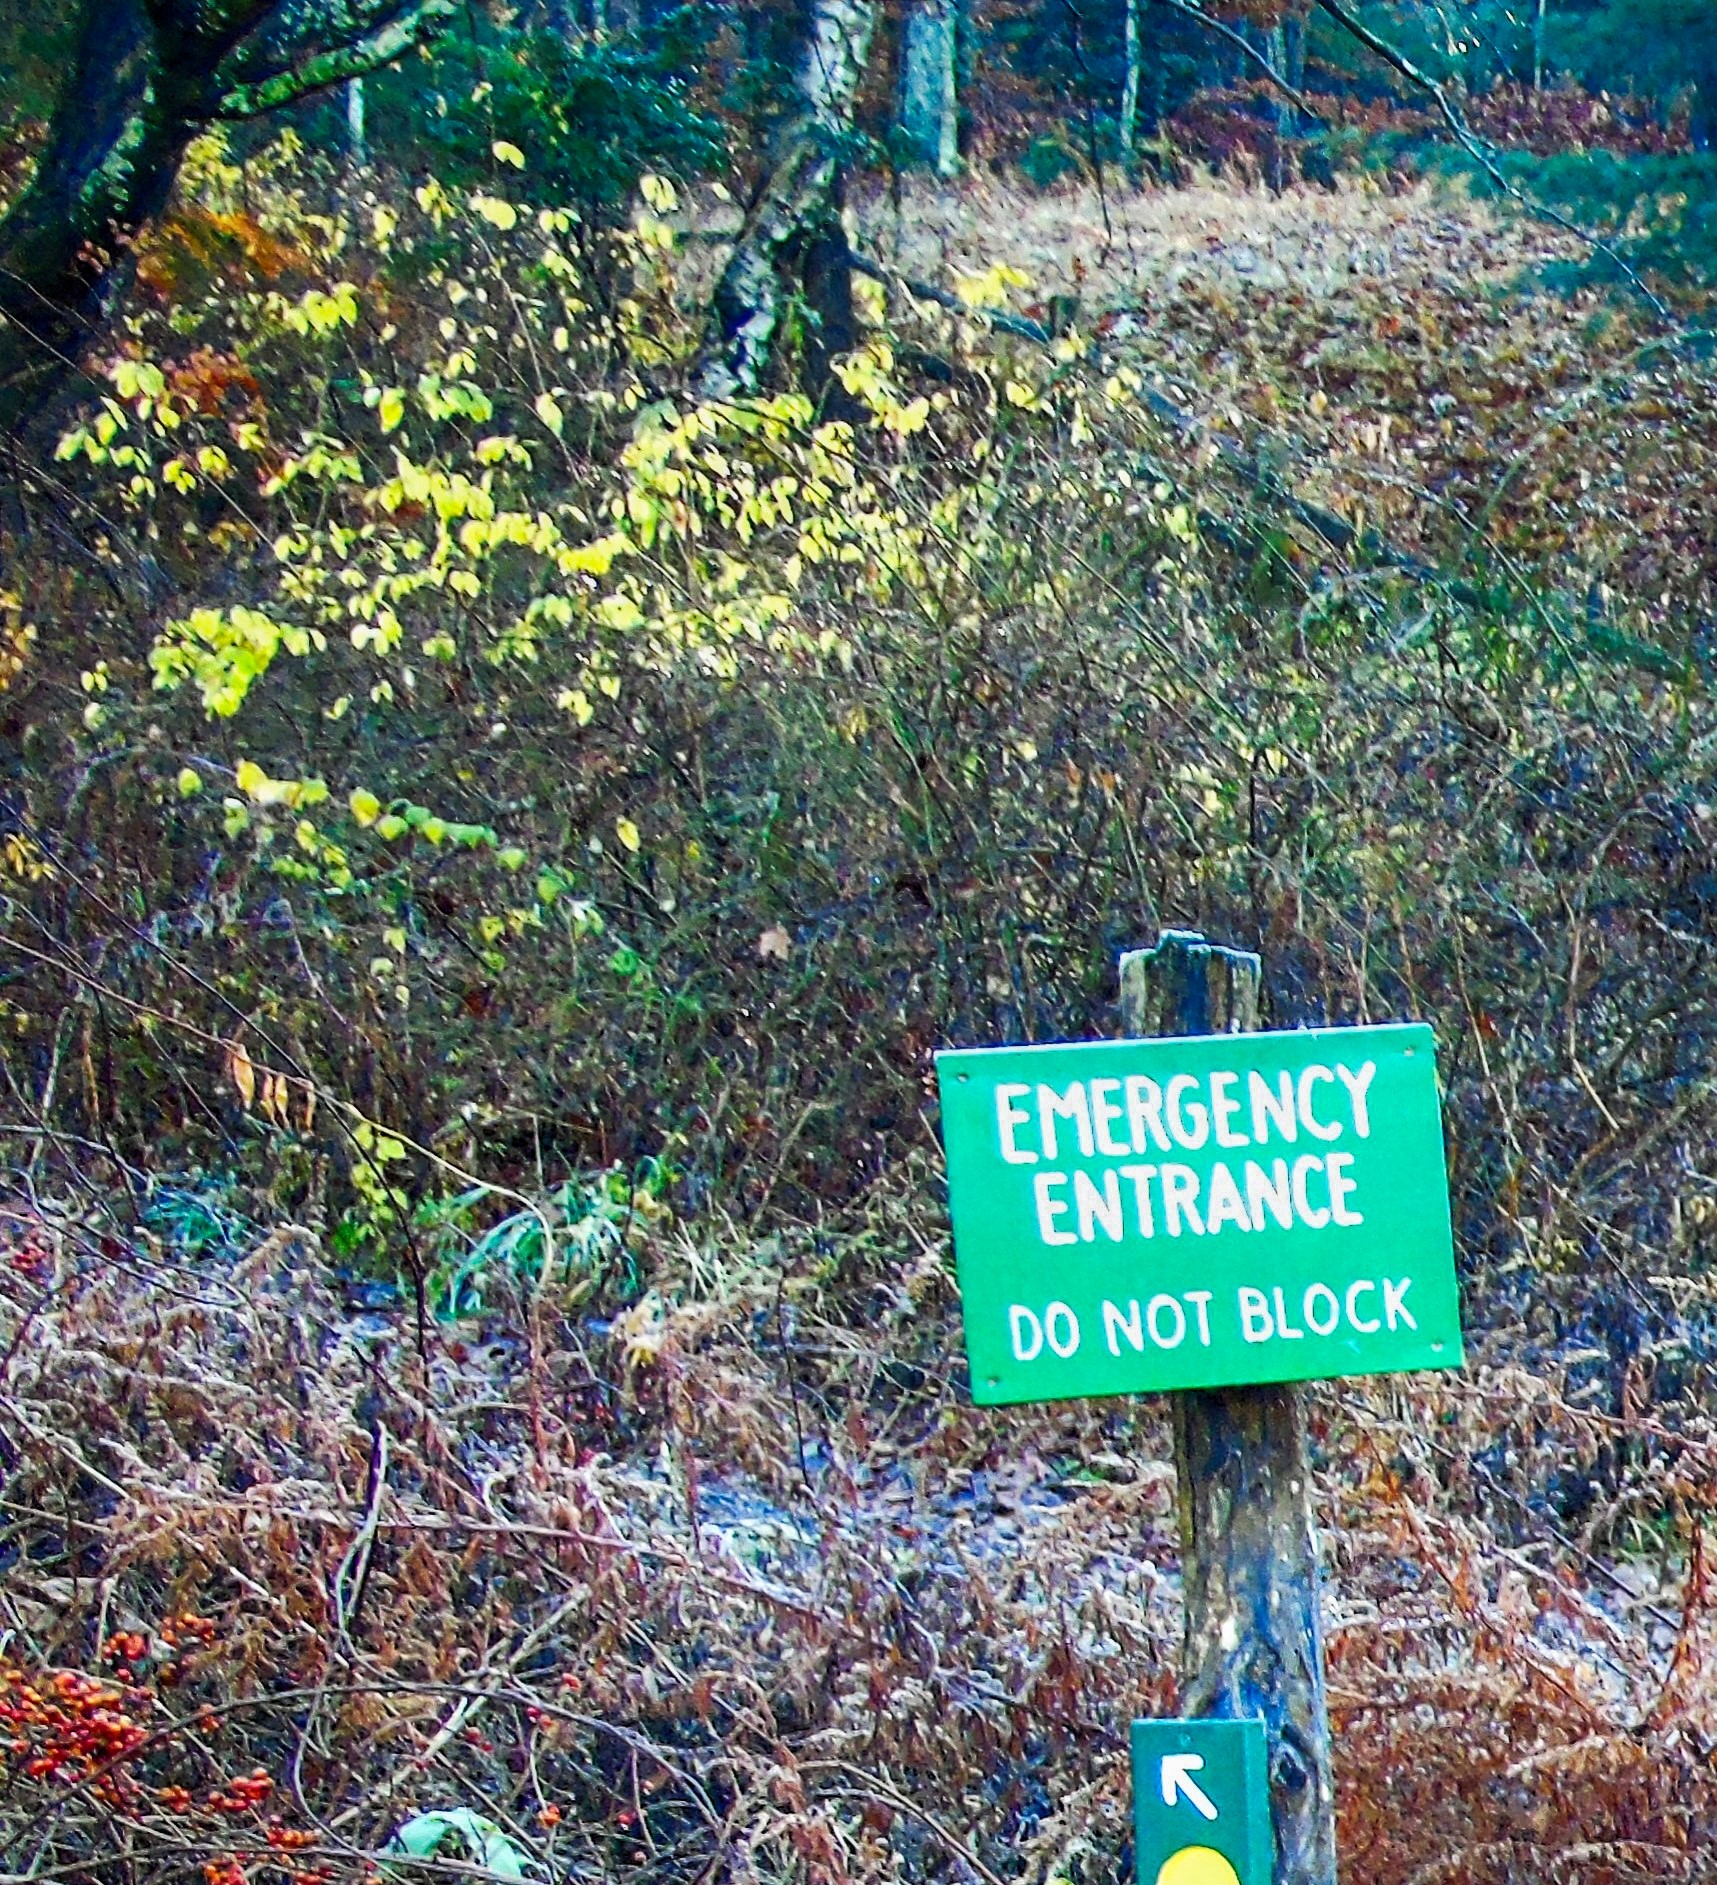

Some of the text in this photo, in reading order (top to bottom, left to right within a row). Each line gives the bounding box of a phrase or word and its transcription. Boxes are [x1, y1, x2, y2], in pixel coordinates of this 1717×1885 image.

[995, 1061, 1377, 1165] EMERGENCY
[1034, 1153, 1364, 1246] ENTRANCE
[1008, 1276, 1418, 1361] DO NOT BLOCK
